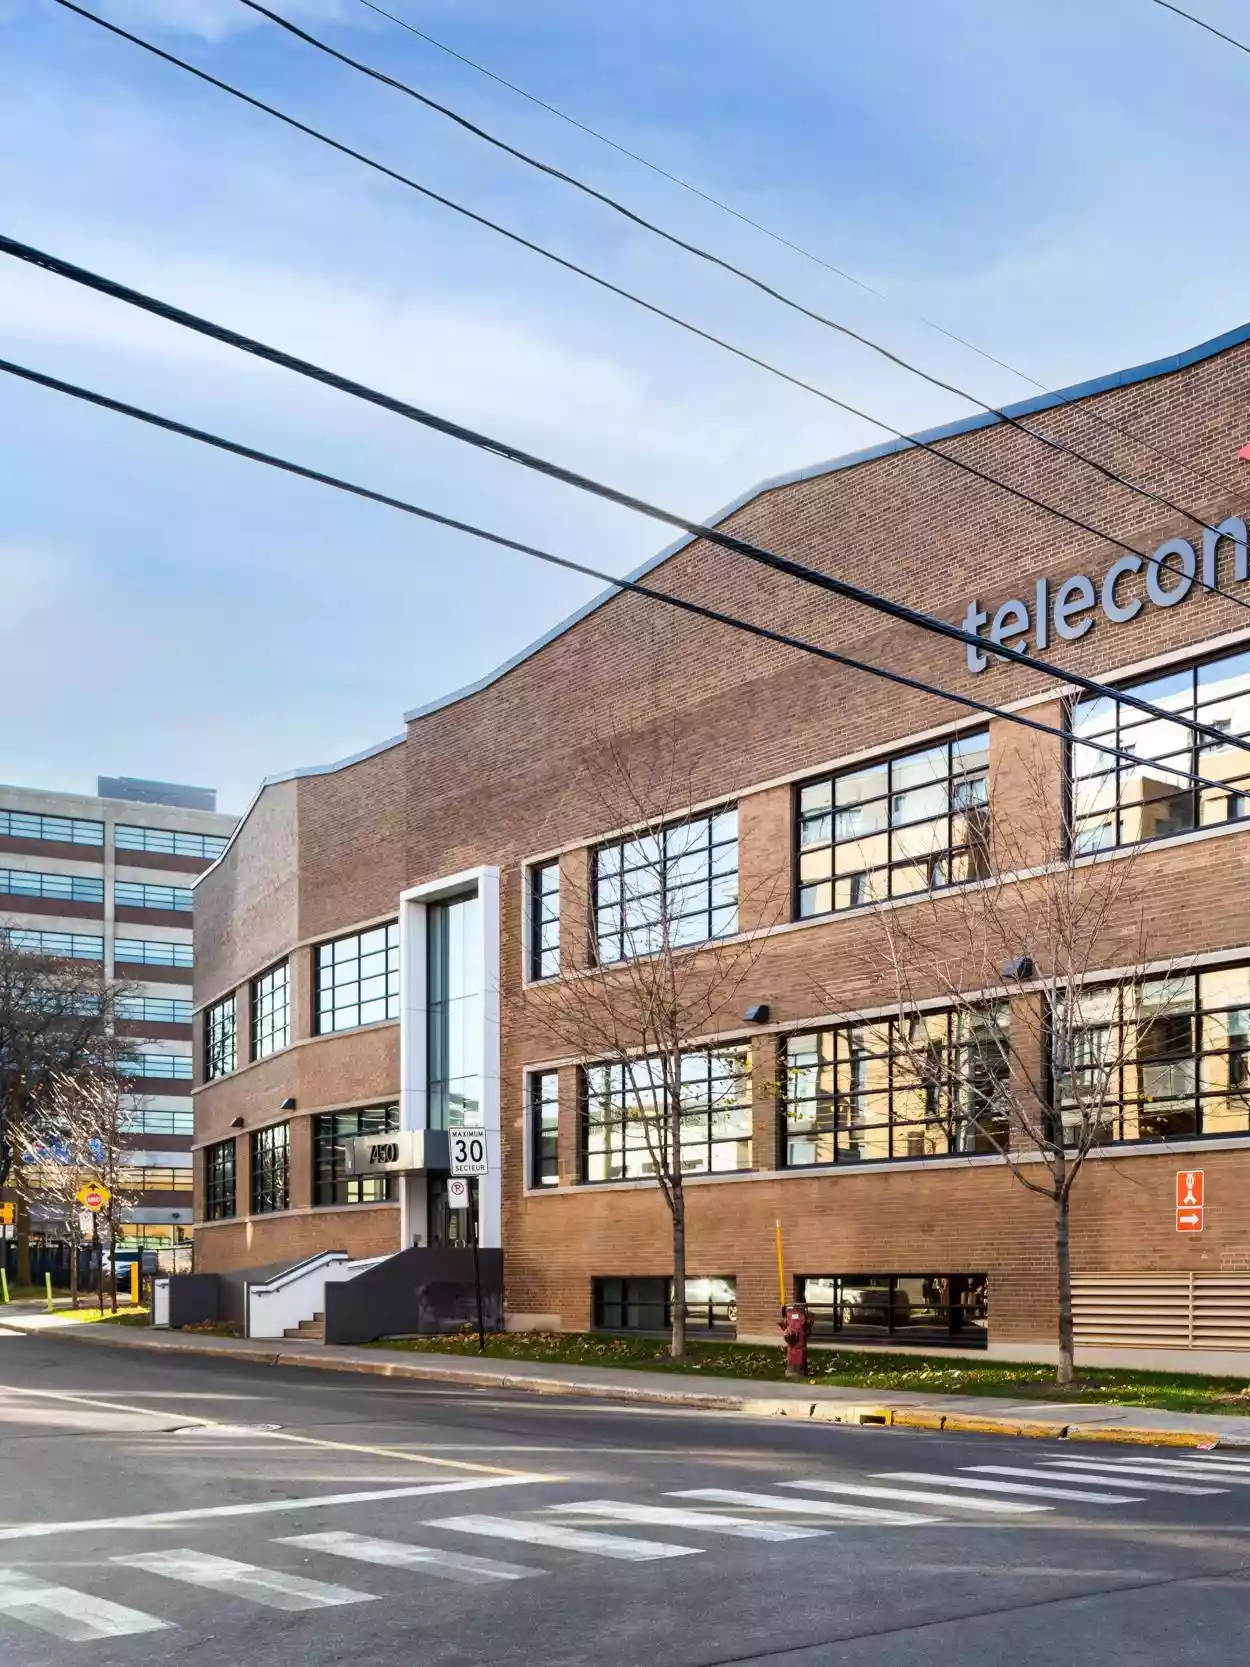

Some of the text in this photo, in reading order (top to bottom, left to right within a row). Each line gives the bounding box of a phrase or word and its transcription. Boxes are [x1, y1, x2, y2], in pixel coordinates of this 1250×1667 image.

[962, 515, 1250, 674] telecon
[455, 1139, 483, 1163] 30
[455, 1164, 485, 1172] SECTEUR
